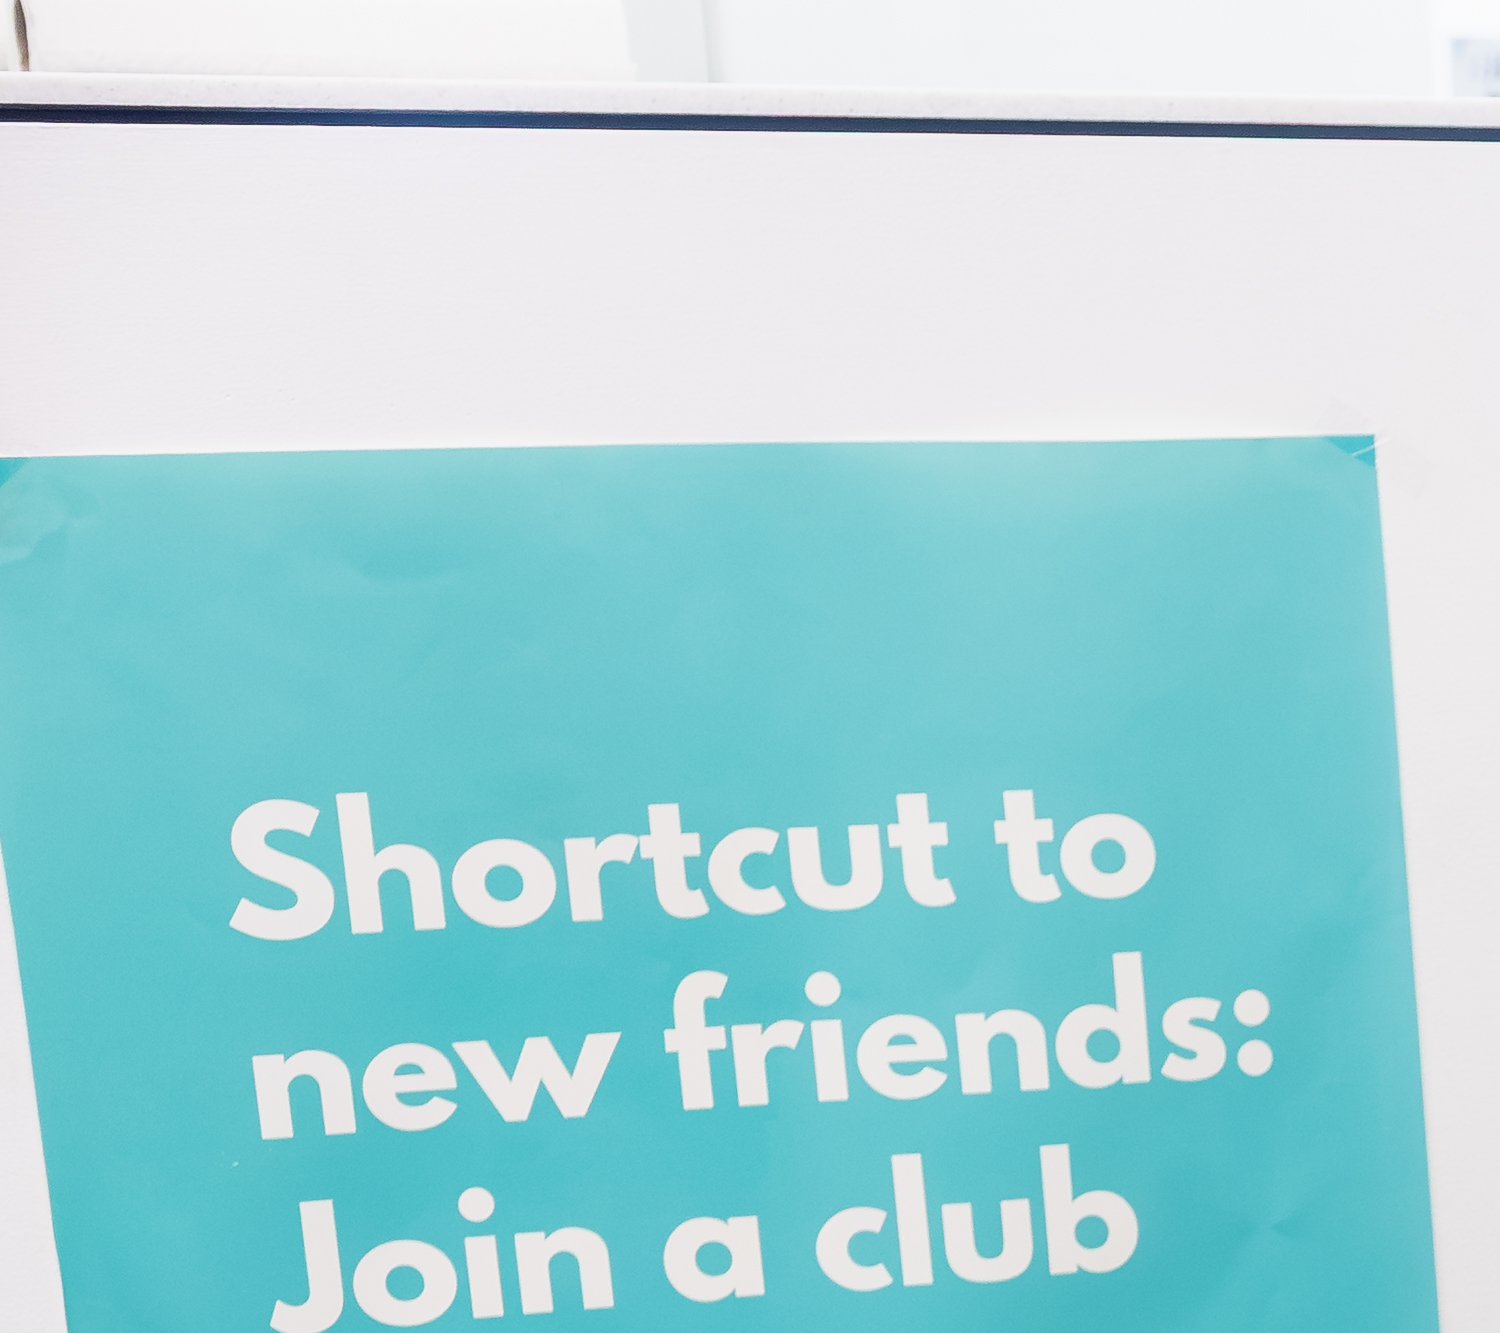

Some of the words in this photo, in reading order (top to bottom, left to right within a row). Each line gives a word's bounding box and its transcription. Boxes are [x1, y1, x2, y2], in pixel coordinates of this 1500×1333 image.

[228, 792, 957, 942] Shortcut
[993, 789, 1157, 904] to
[251, 1030, 622, 1141] new
[663, 950, 1274, 1111] friends:
[663, 1215, 766, 1303] a
[815, 1143, 1140, 1293] club
